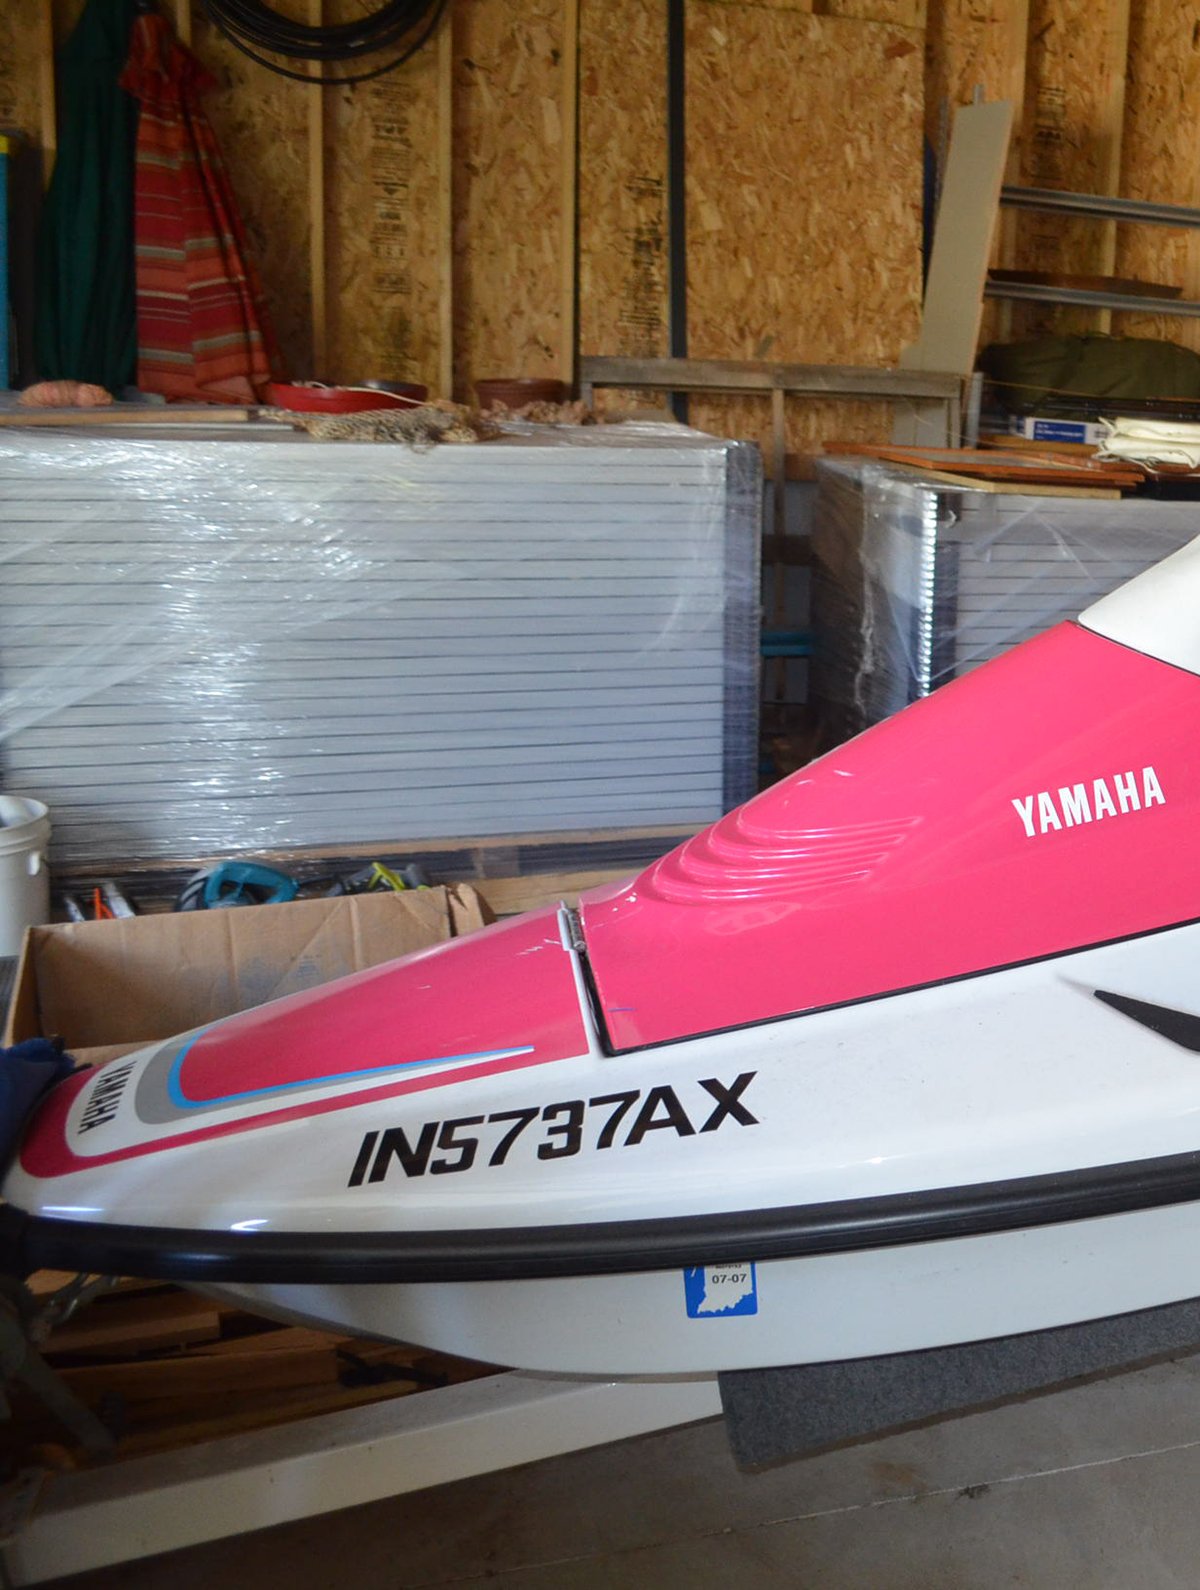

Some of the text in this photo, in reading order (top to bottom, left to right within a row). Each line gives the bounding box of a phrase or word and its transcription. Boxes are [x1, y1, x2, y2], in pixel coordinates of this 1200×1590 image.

[1011, 766, 1166, 837] YAMAHA
[78, 1061, 137, 1135] YAMAHA
[347, 1071, 760, 1188] IN5737AX
[711, 1273, 747, 1284] 07-07
